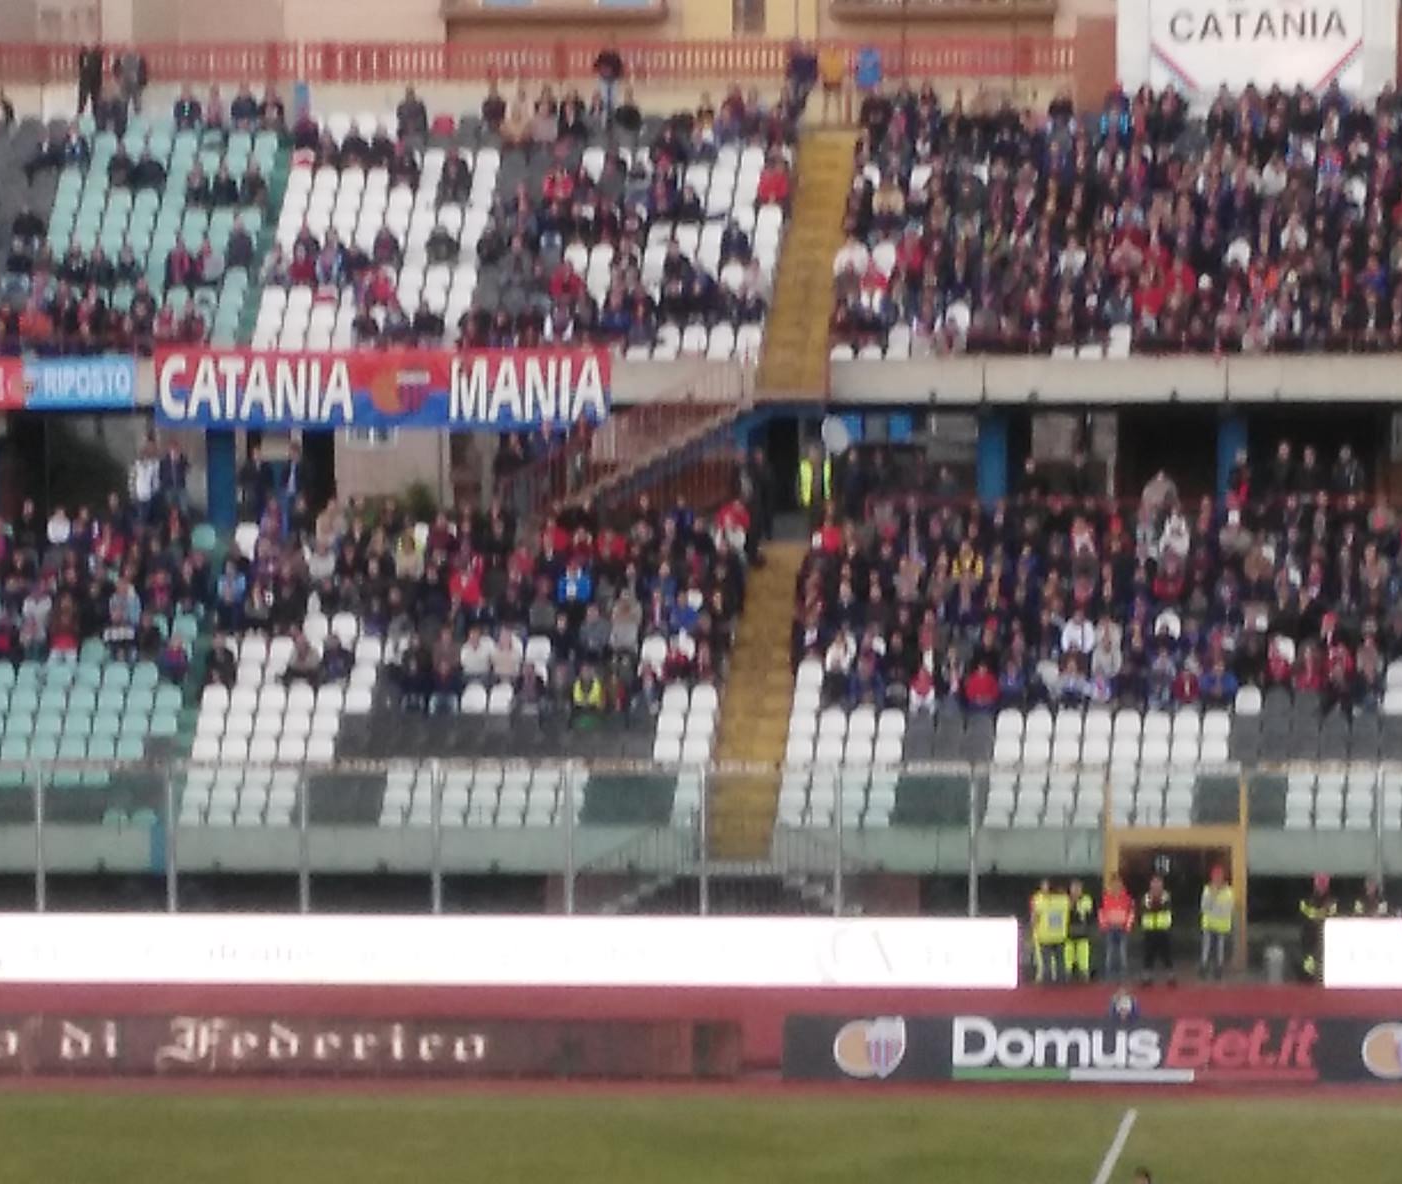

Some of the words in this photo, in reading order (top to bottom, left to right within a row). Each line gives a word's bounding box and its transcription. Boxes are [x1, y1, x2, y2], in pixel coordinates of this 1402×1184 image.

[1168, 8, 1347, 42] CATANIA
[43, 363, 131, 398] RIPOSTO
[158, 353, 354, 422] CATANIA
[449, 354, 608, 422] MANIA
[59, 1018, 119, 1060] di
[154, 1014, 486, 1073] Federico
